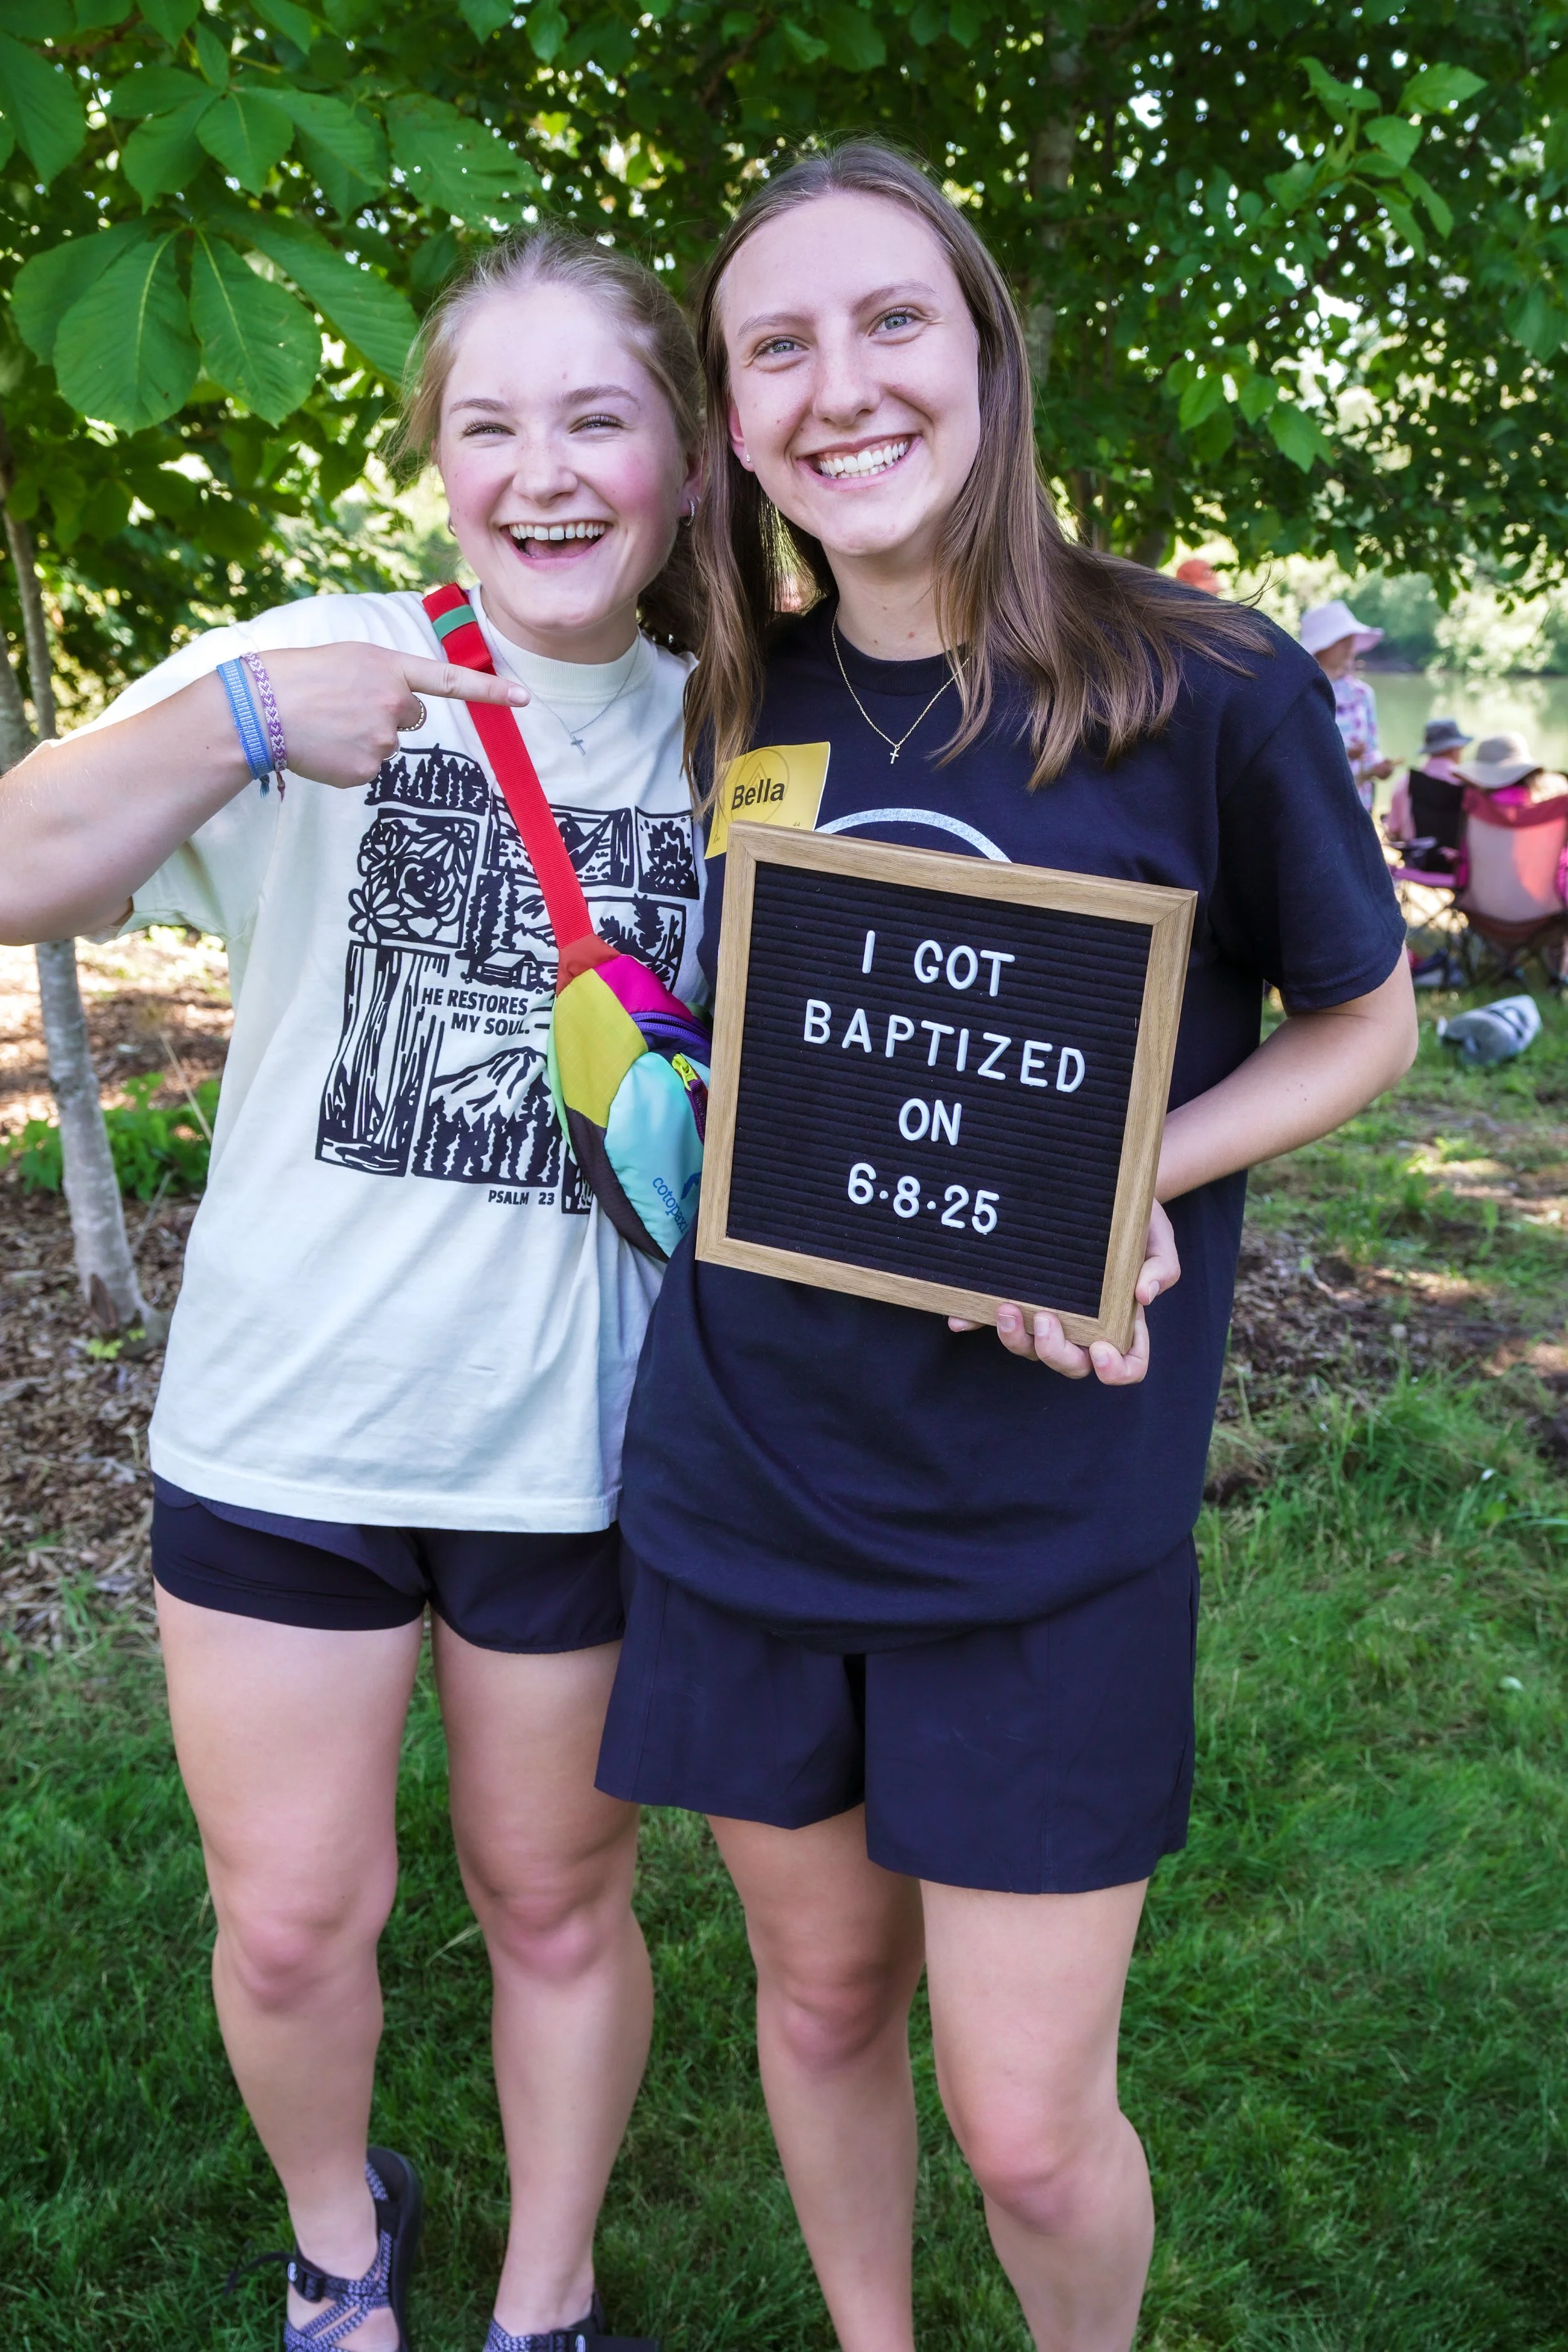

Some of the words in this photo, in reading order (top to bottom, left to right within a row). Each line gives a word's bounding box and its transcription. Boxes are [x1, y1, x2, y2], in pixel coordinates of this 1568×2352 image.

[731, 778, 785, 810] Bella
[862, 930, 876, 974] I
[913, 940, 1015, 997] GOT
[421, 987, 444, 1005] HE
[447, 989, 529, 1015] RESTORES
[451, 1012, 480, 1033] MY
[484, 1017, 530, 1036] SOUL.
[803, 999, 1086, 1093] BAPTIZED
[898, 1098, 962, 1146] ON
[488, 1189, 529, 1205] PSALM
[538, 1192, 554, 1205] 23
[652, 1177, 690, 1234] cotopaxi
